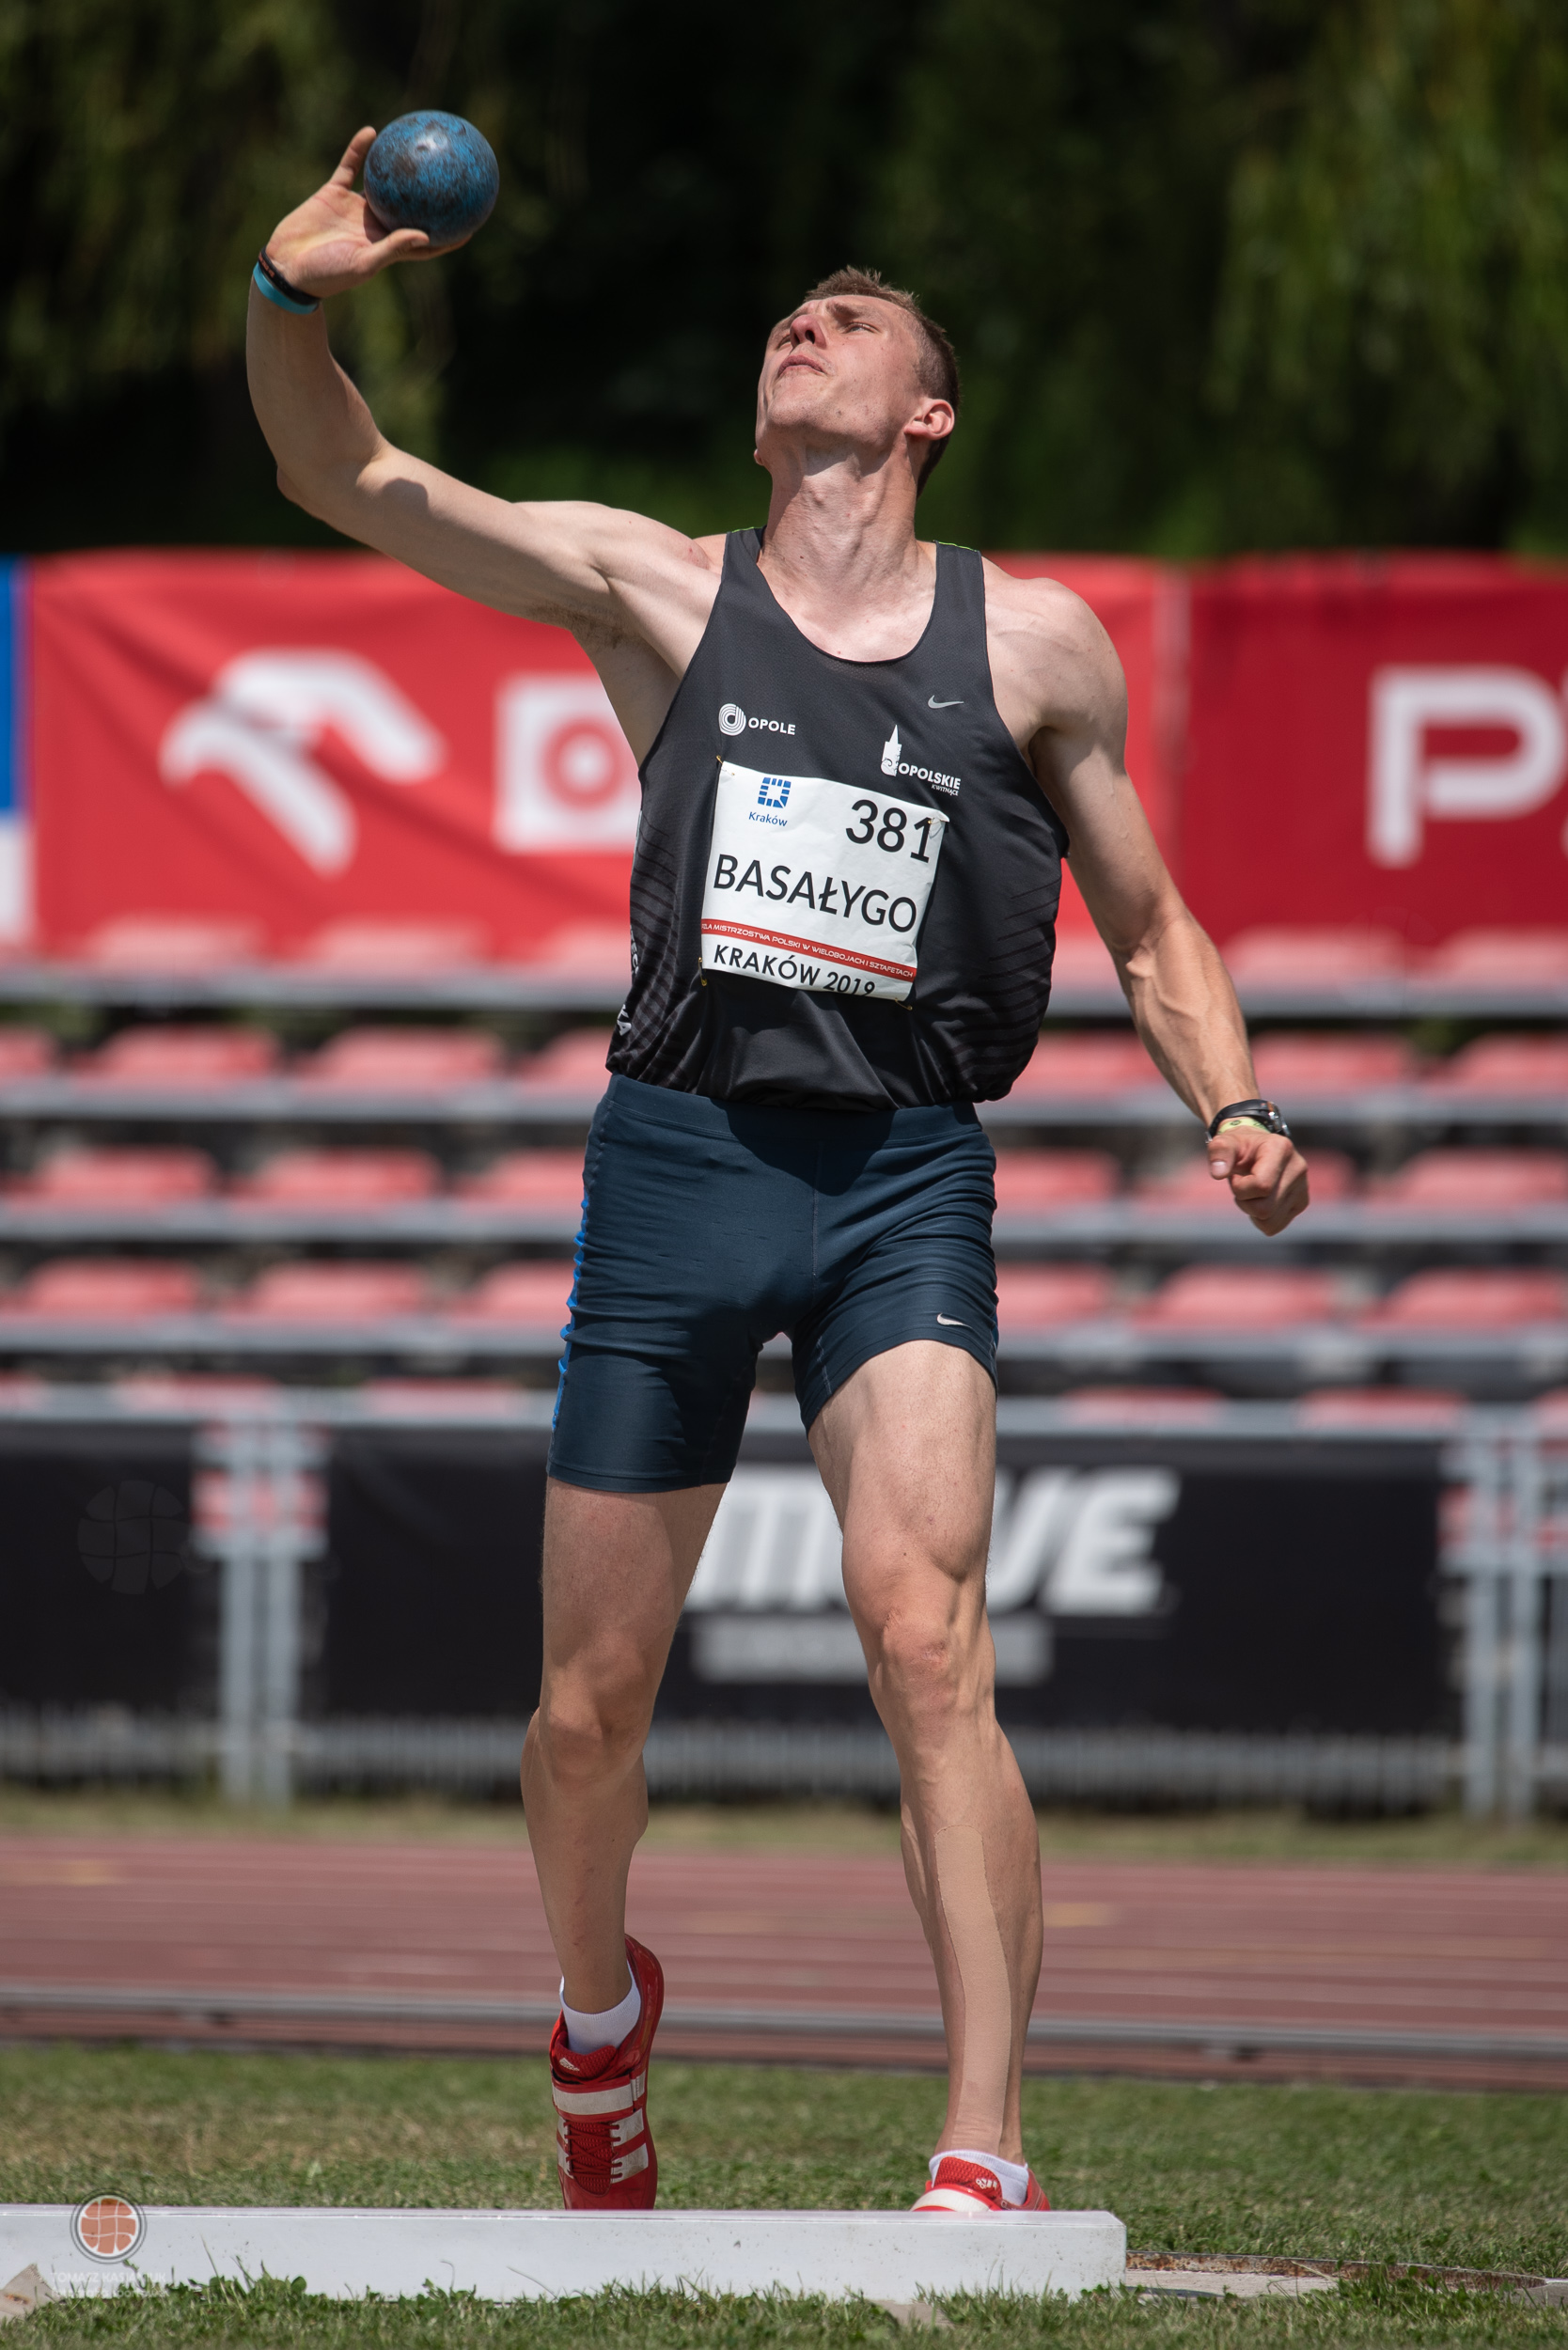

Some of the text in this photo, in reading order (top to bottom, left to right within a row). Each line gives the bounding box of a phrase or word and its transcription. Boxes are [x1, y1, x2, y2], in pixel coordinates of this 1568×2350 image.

[748, 717, 795, 735] OPOLE
[897, 762, 961, 790] OPOLSKIE
[1368, 664, 1568, 869] P
[748, 811, 788, 827] Kraków
[845, 799, 932, 863] 381
[713, 854, 917, 932] BASAŁYGO
[713, 924, 771, 941] MISTRZOSTWA
[771, 936, 801, 948] POLSKI
[811, 946, 865, 965] WIELOBOJACH
[869, 961, 914, 978] SZTAFETACH
[713, 944, 875, 996] KRAKÓW 2019
